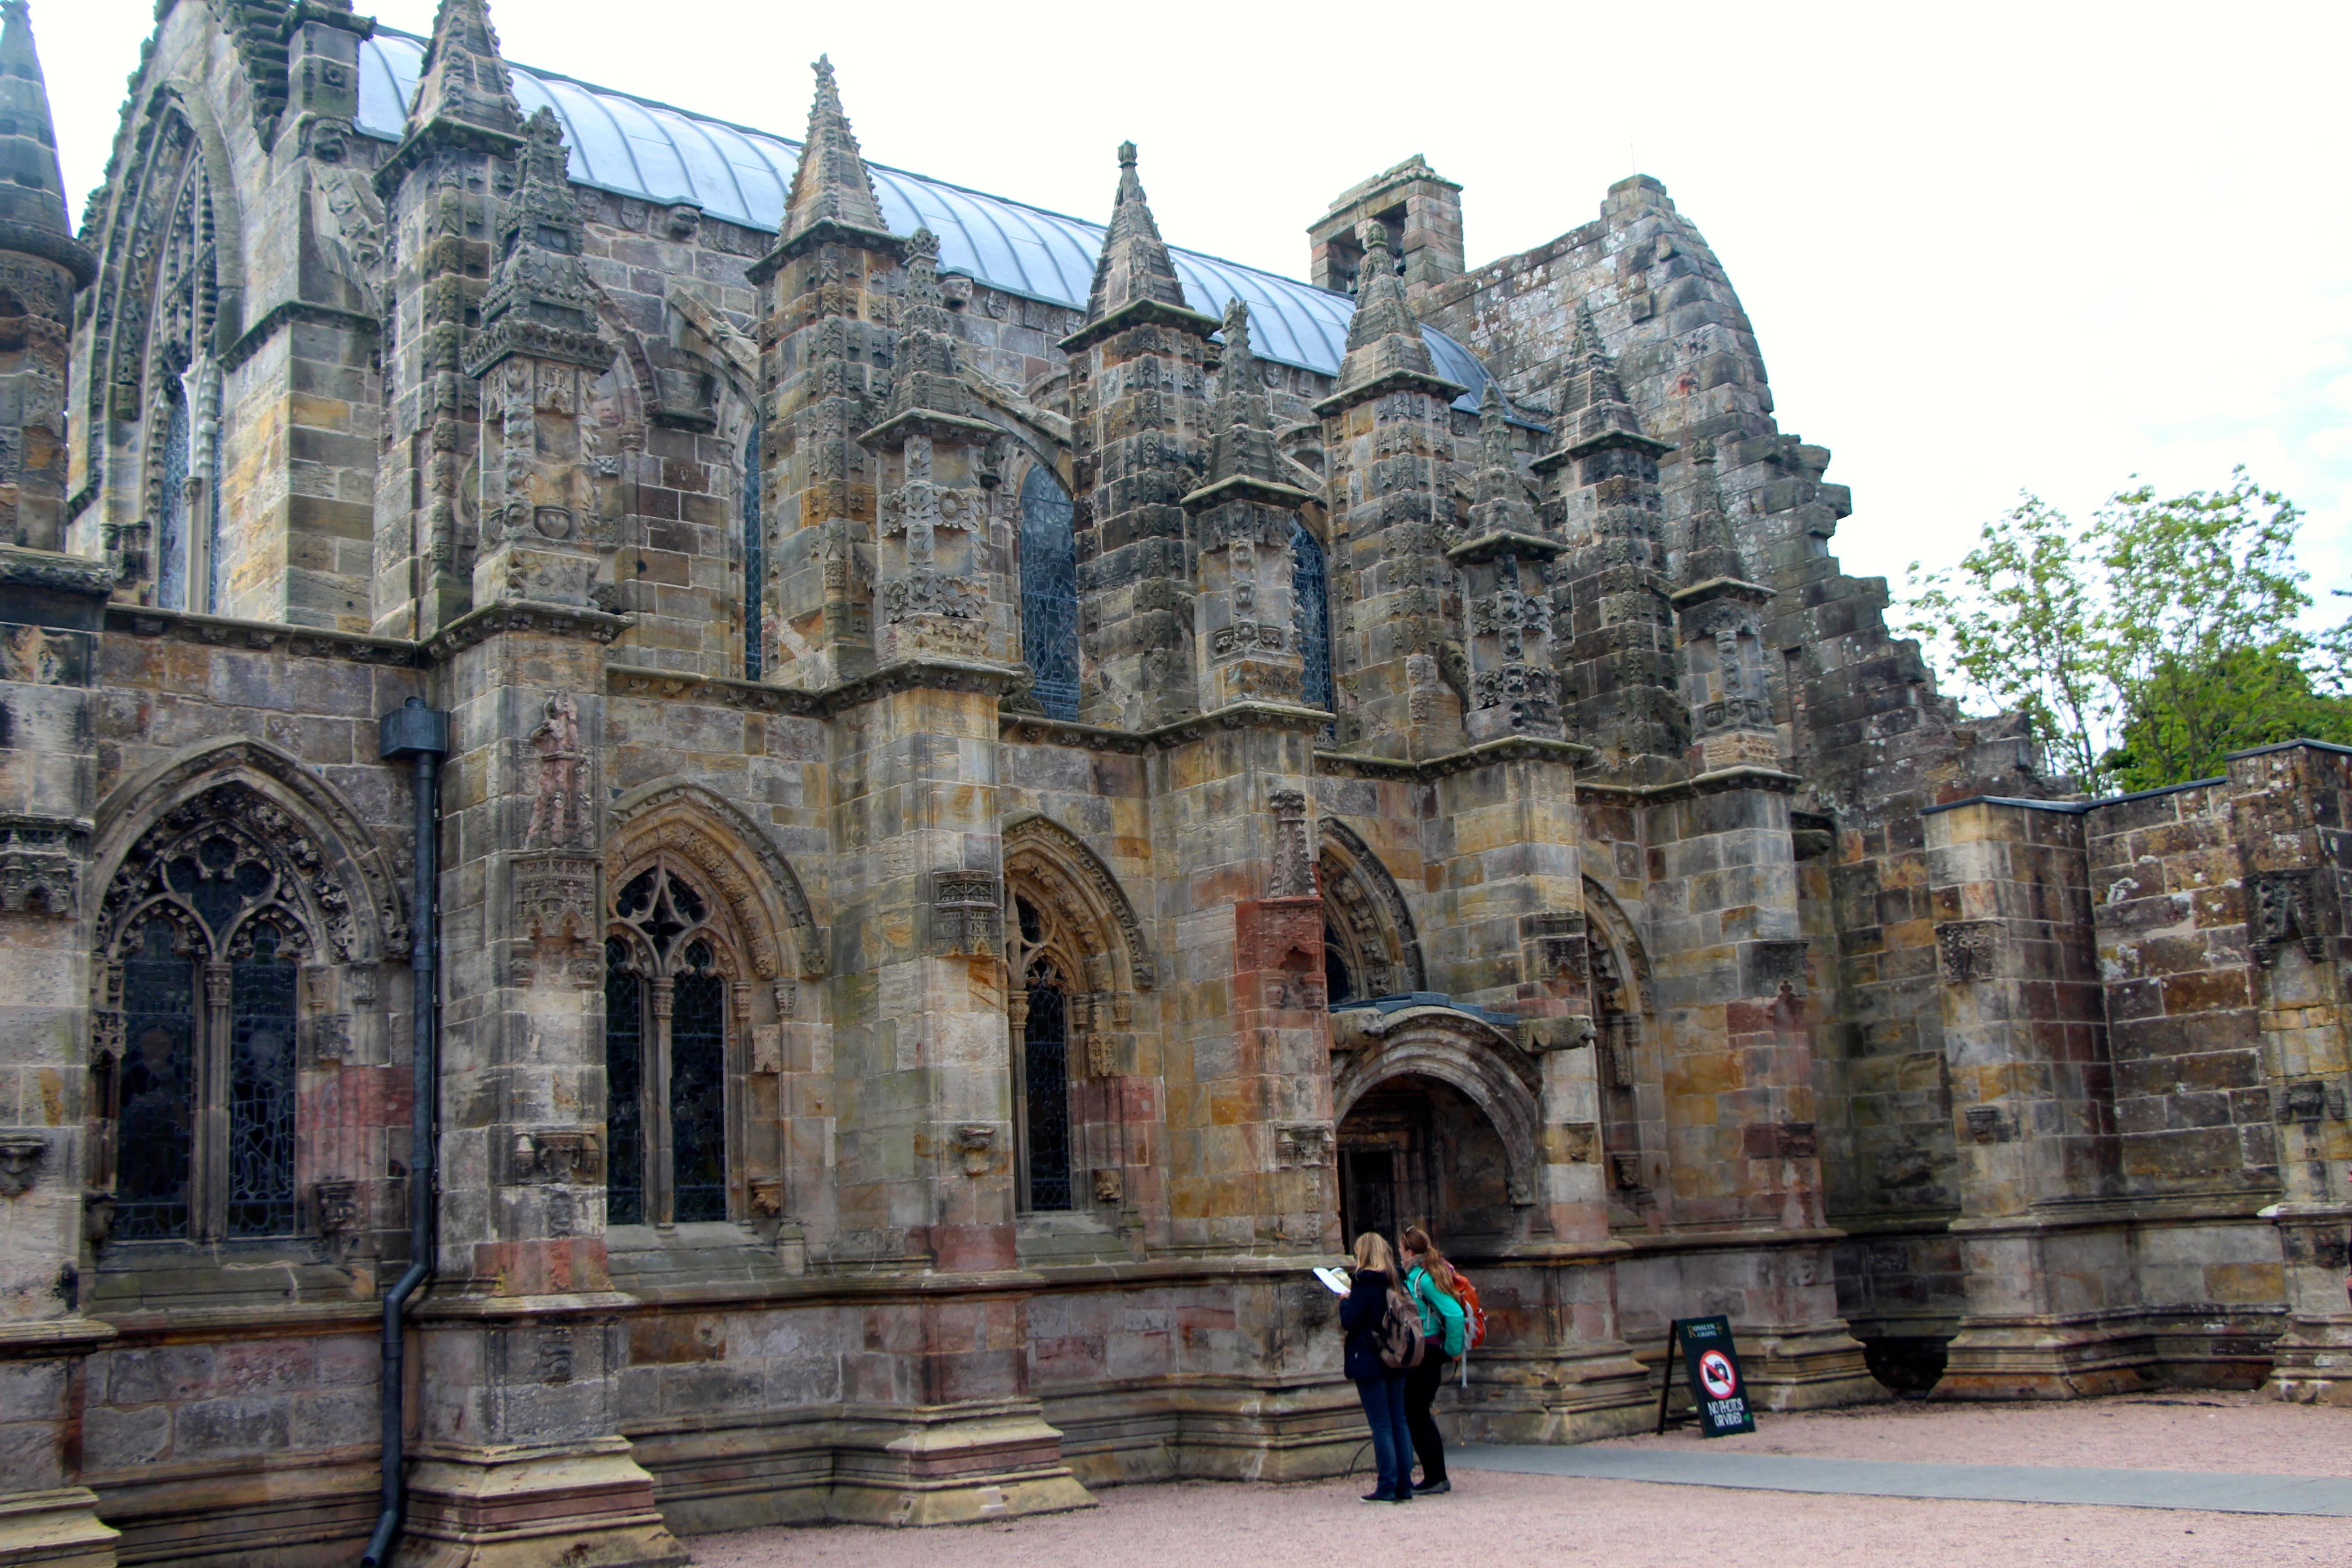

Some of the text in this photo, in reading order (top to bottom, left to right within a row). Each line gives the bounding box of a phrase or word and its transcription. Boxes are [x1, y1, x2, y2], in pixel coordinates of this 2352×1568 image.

[1708, 1398, 1743, 1415] NO PHOTOS
[1715, 1412, 1742, 1426] OR VIDEO
